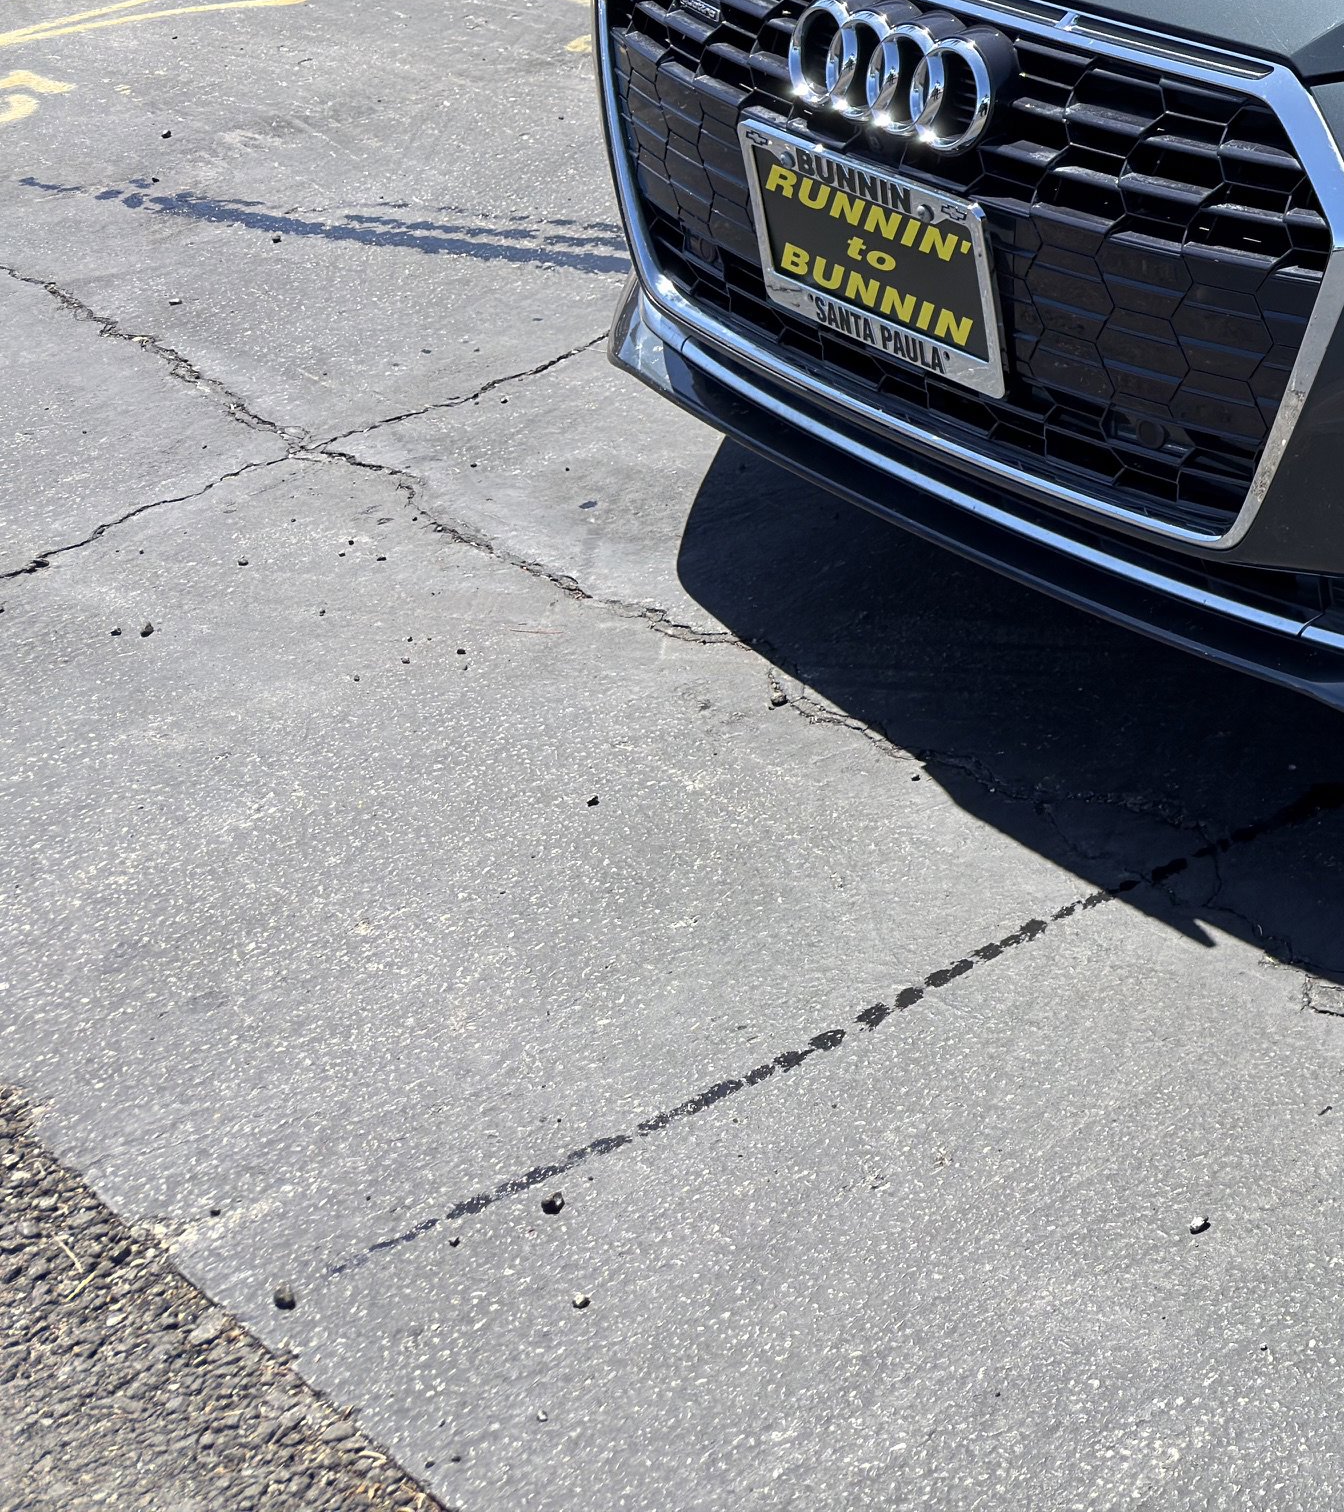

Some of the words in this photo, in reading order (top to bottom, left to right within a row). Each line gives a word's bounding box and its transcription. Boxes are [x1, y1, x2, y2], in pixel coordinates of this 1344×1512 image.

[765, 164, 972, 262] RUNNIN'
[796, 147, 911, 213] BUNNIN
[847, 236, 897, 271] to
[780, 242, 974, 346] BUNNIN
[814, 296, 877, 344] SANTA
[880, 324, 945, 374] PAULA
